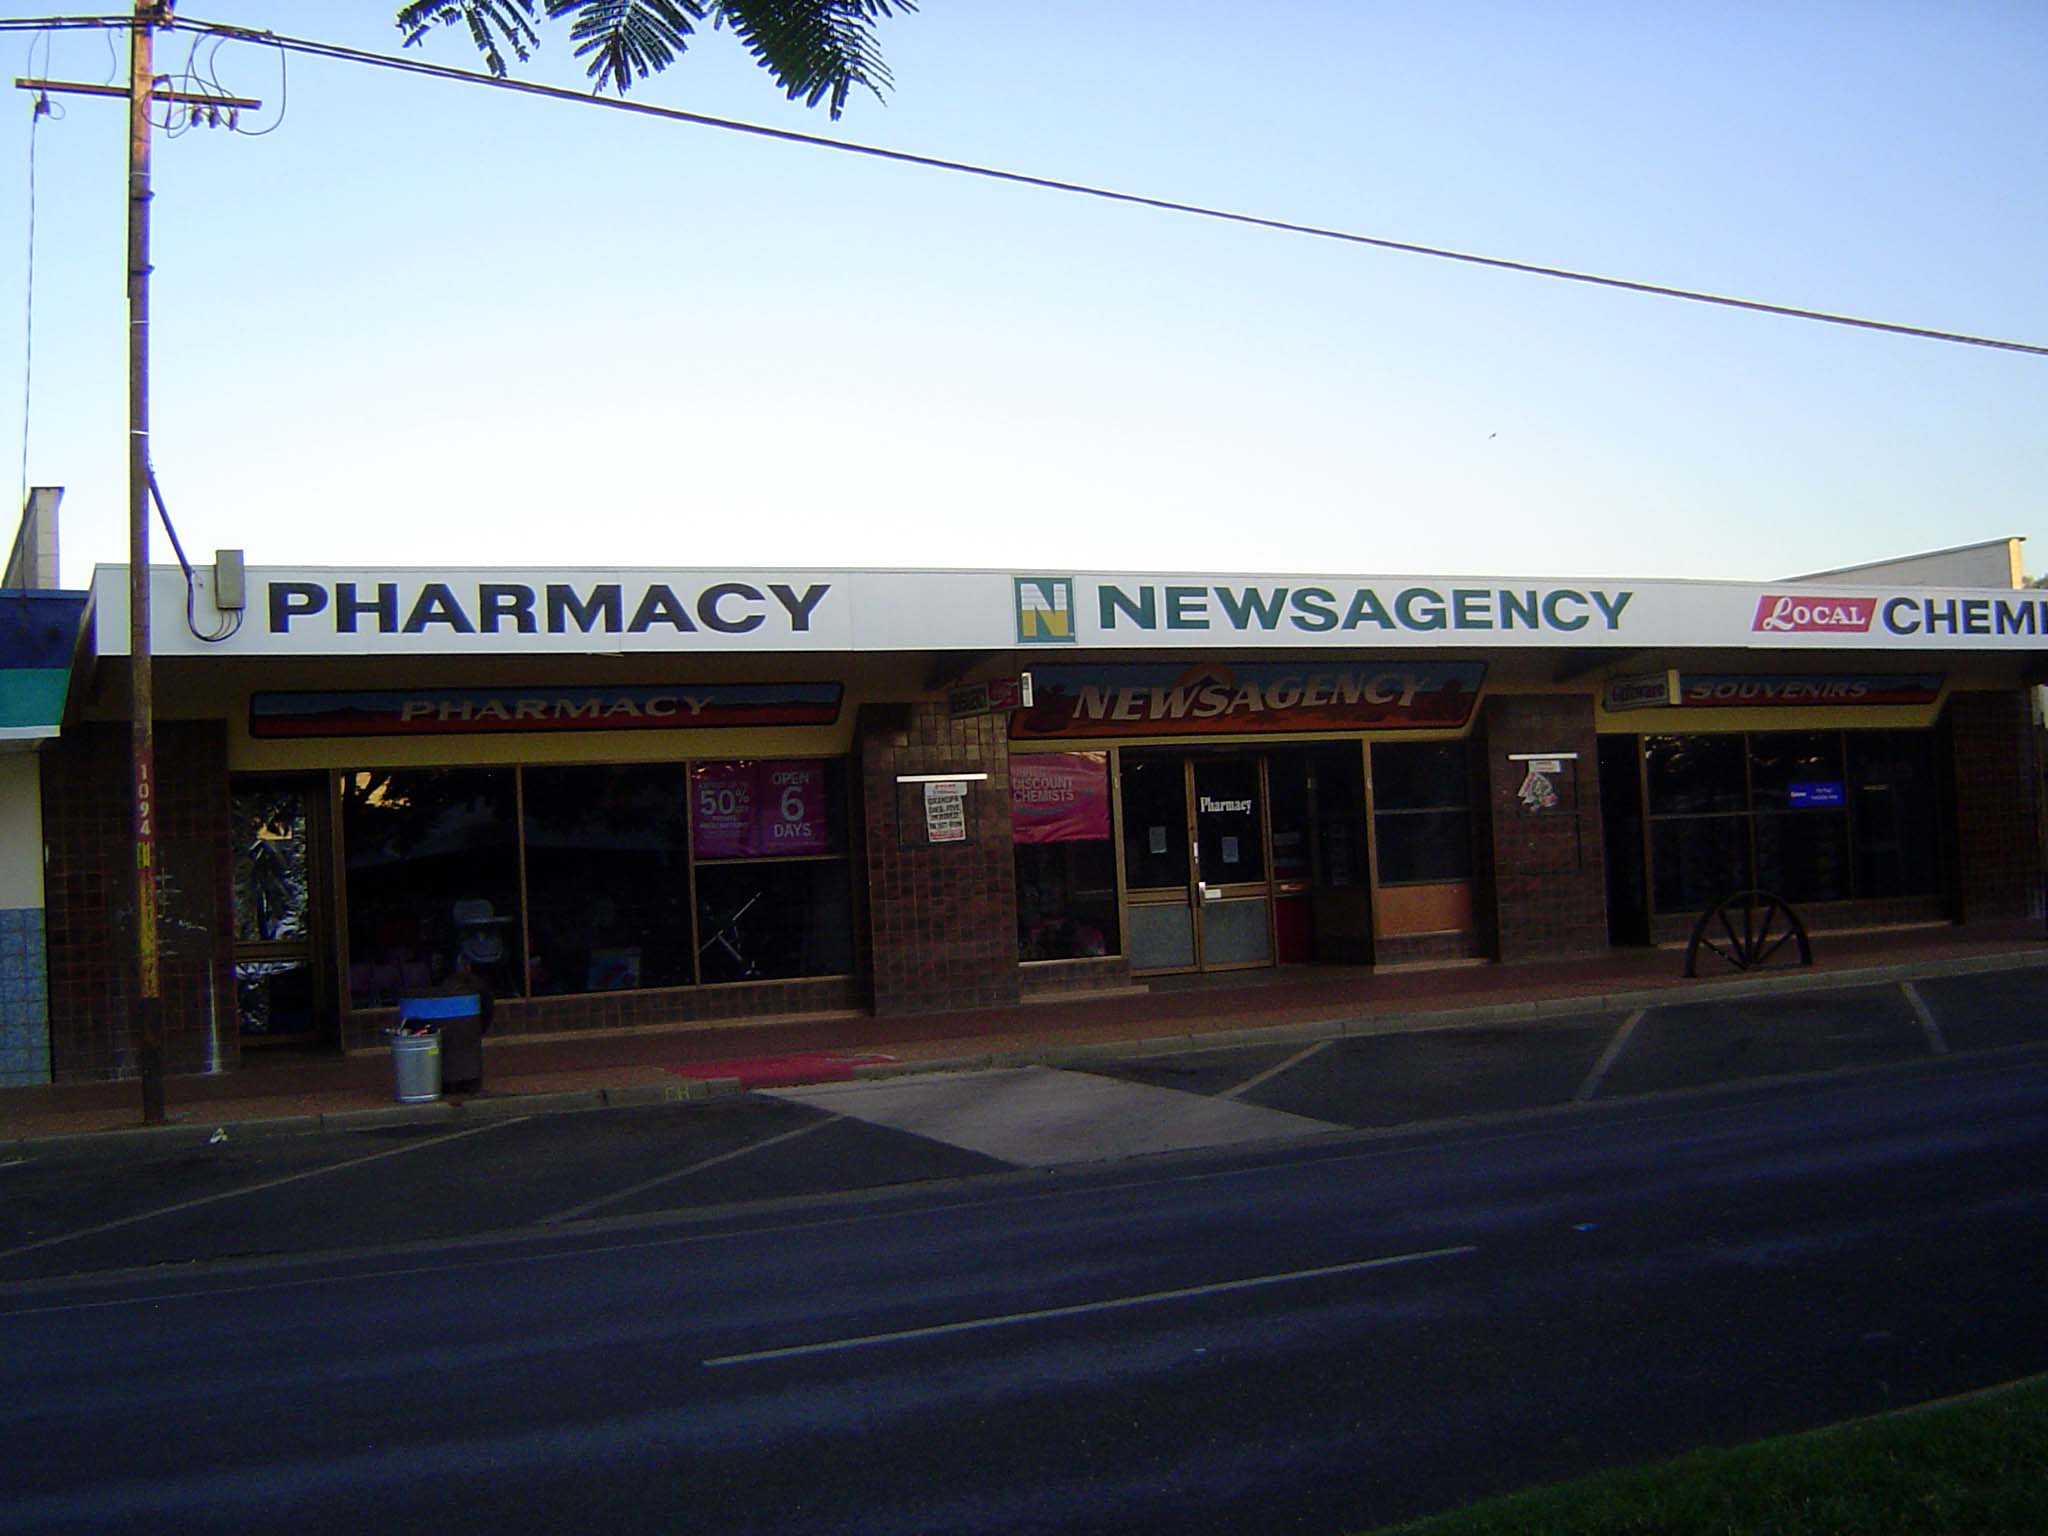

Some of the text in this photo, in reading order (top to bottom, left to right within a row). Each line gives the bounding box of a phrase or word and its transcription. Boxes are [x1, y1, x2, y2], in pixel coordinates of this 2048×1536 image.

[267, 581, 832, 635] PHARMACY
[1098, 584, 1633, 632] NEWSAGENCY
[1072, 671, 1431, 723] NEWSAGENCY
[1689, 680, 1872, 700] SOUVENIRS
[400, 695, 712, 723] PHARMACY
[772, 771, 810, 785] OPEN
[1013, 776, 1073, 790] DISCOUNT
[137, 763, 151, 836] 1094
[781, 785, 806, 822] 6
[1013, 789, 1075, 802] CHEMISTS
[1200, 796, 1252, 815] Pharmacy
[773, 823, 813, 838] DAYS
